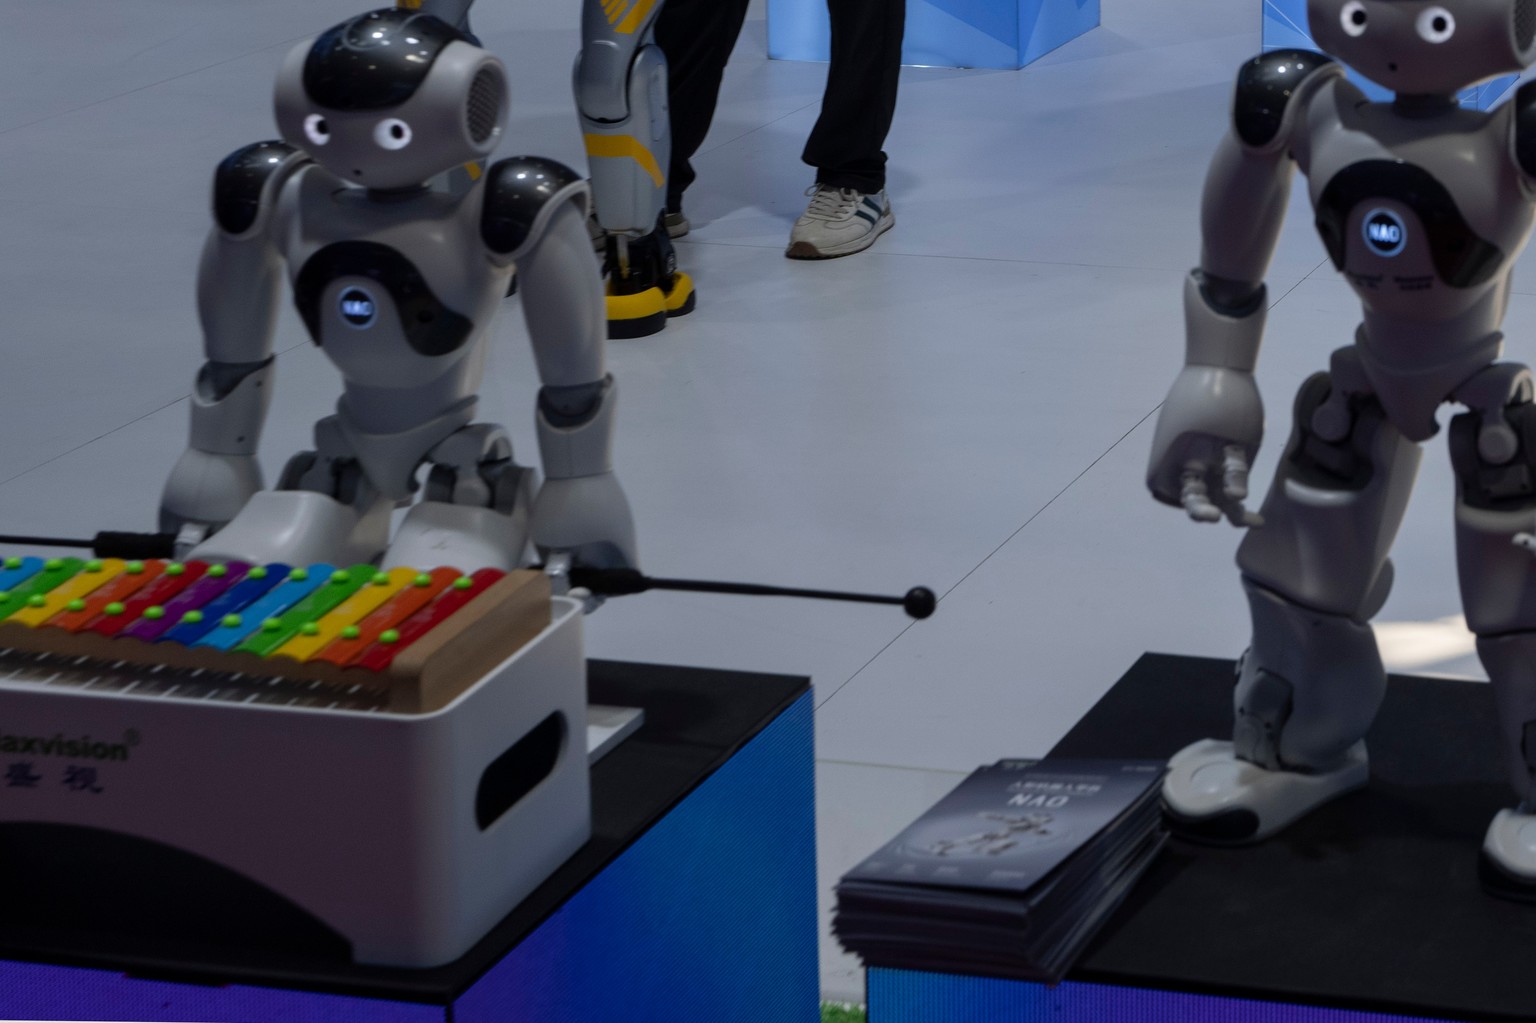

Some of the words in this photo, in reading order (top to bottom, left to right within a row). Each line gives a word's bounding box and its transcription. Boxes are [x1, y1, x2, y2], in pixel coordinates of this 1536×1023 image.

[1368, 223, 1401, 243] NAO
[0, 730, 130, 761] axvision
[1006, 792, 1070, 807] NAO
